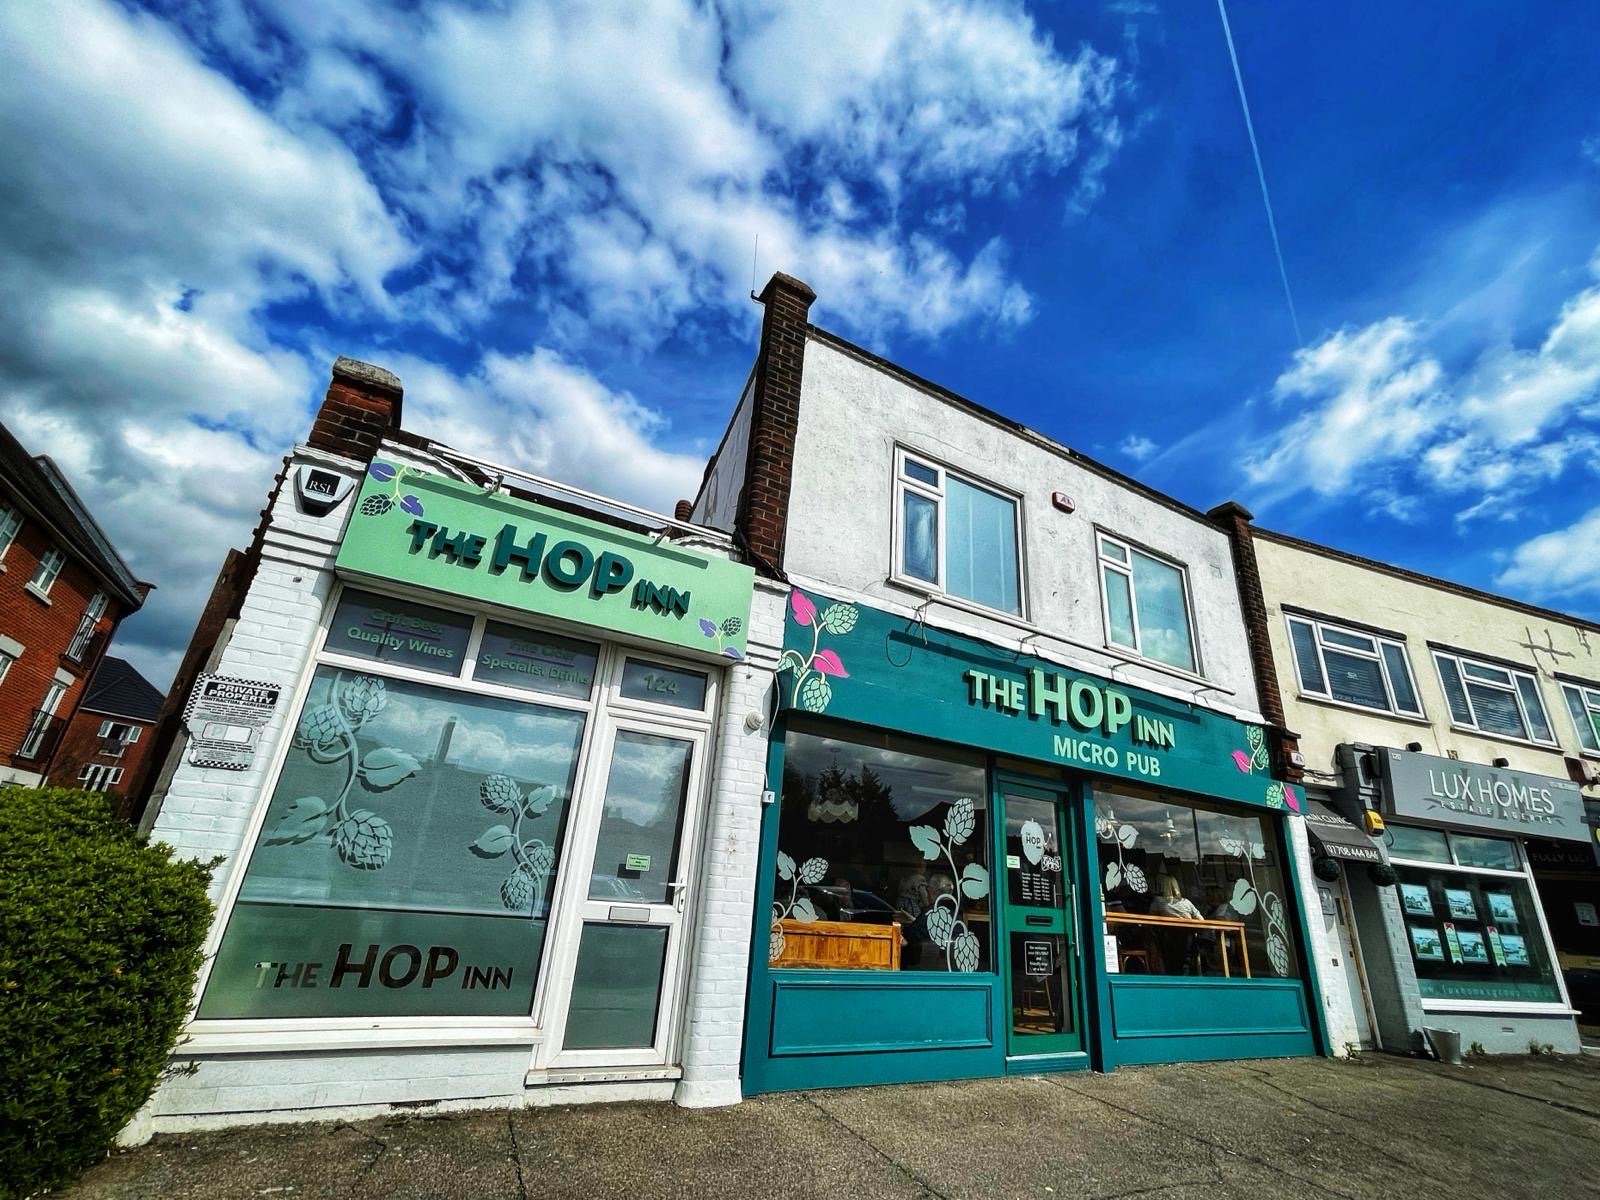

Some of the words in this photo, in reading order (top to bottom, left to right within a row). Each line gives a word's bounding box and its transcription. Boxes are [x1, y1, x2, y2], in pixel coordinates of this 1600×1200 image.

[309, 480, 332, 494] RSI
[409, 519, 488, 567] THE
[492, 523, 636, 598] HOP
[633, 578, 692, 619] INN
[347, 626, 405, 651] Quality
[408, 638, 455, 658] Wines
[481, 654, 547, 676] Specialist
[549, 666, 591, 686] Drinks
[216, 683, 270, 698] PRIVATE
[643, 673, 680, 695] 124
[200, 696, 241, 706] CONTRACTUAL
[242, 701, 276, 710] AGREEMENT
[208, 689, 274, 704] PROPERTY
[968, 668, 1026, 712] THE
[1029, 667, 1133, 734] HOP
[1134, 714, 1176, 749] INN
[1053, 734, 1119, 768] MICRO
[1126, 751, 1161, 777] PUB
[1428, 769, 1475, 802] LUX
[1476, 777, 1555, 815] HOMES
[1321, 815, 1352, 825] CLINIC
[1440, 800, 1493, 815] ESTATE
[1503, 811, 1552, 824] AGENTS
[1026, 836, 1041, 846] HOP
[254, 961, 323, 989] THE
[328, 943, 460, 989] HOP
[461, 965, 514, 990] INN
